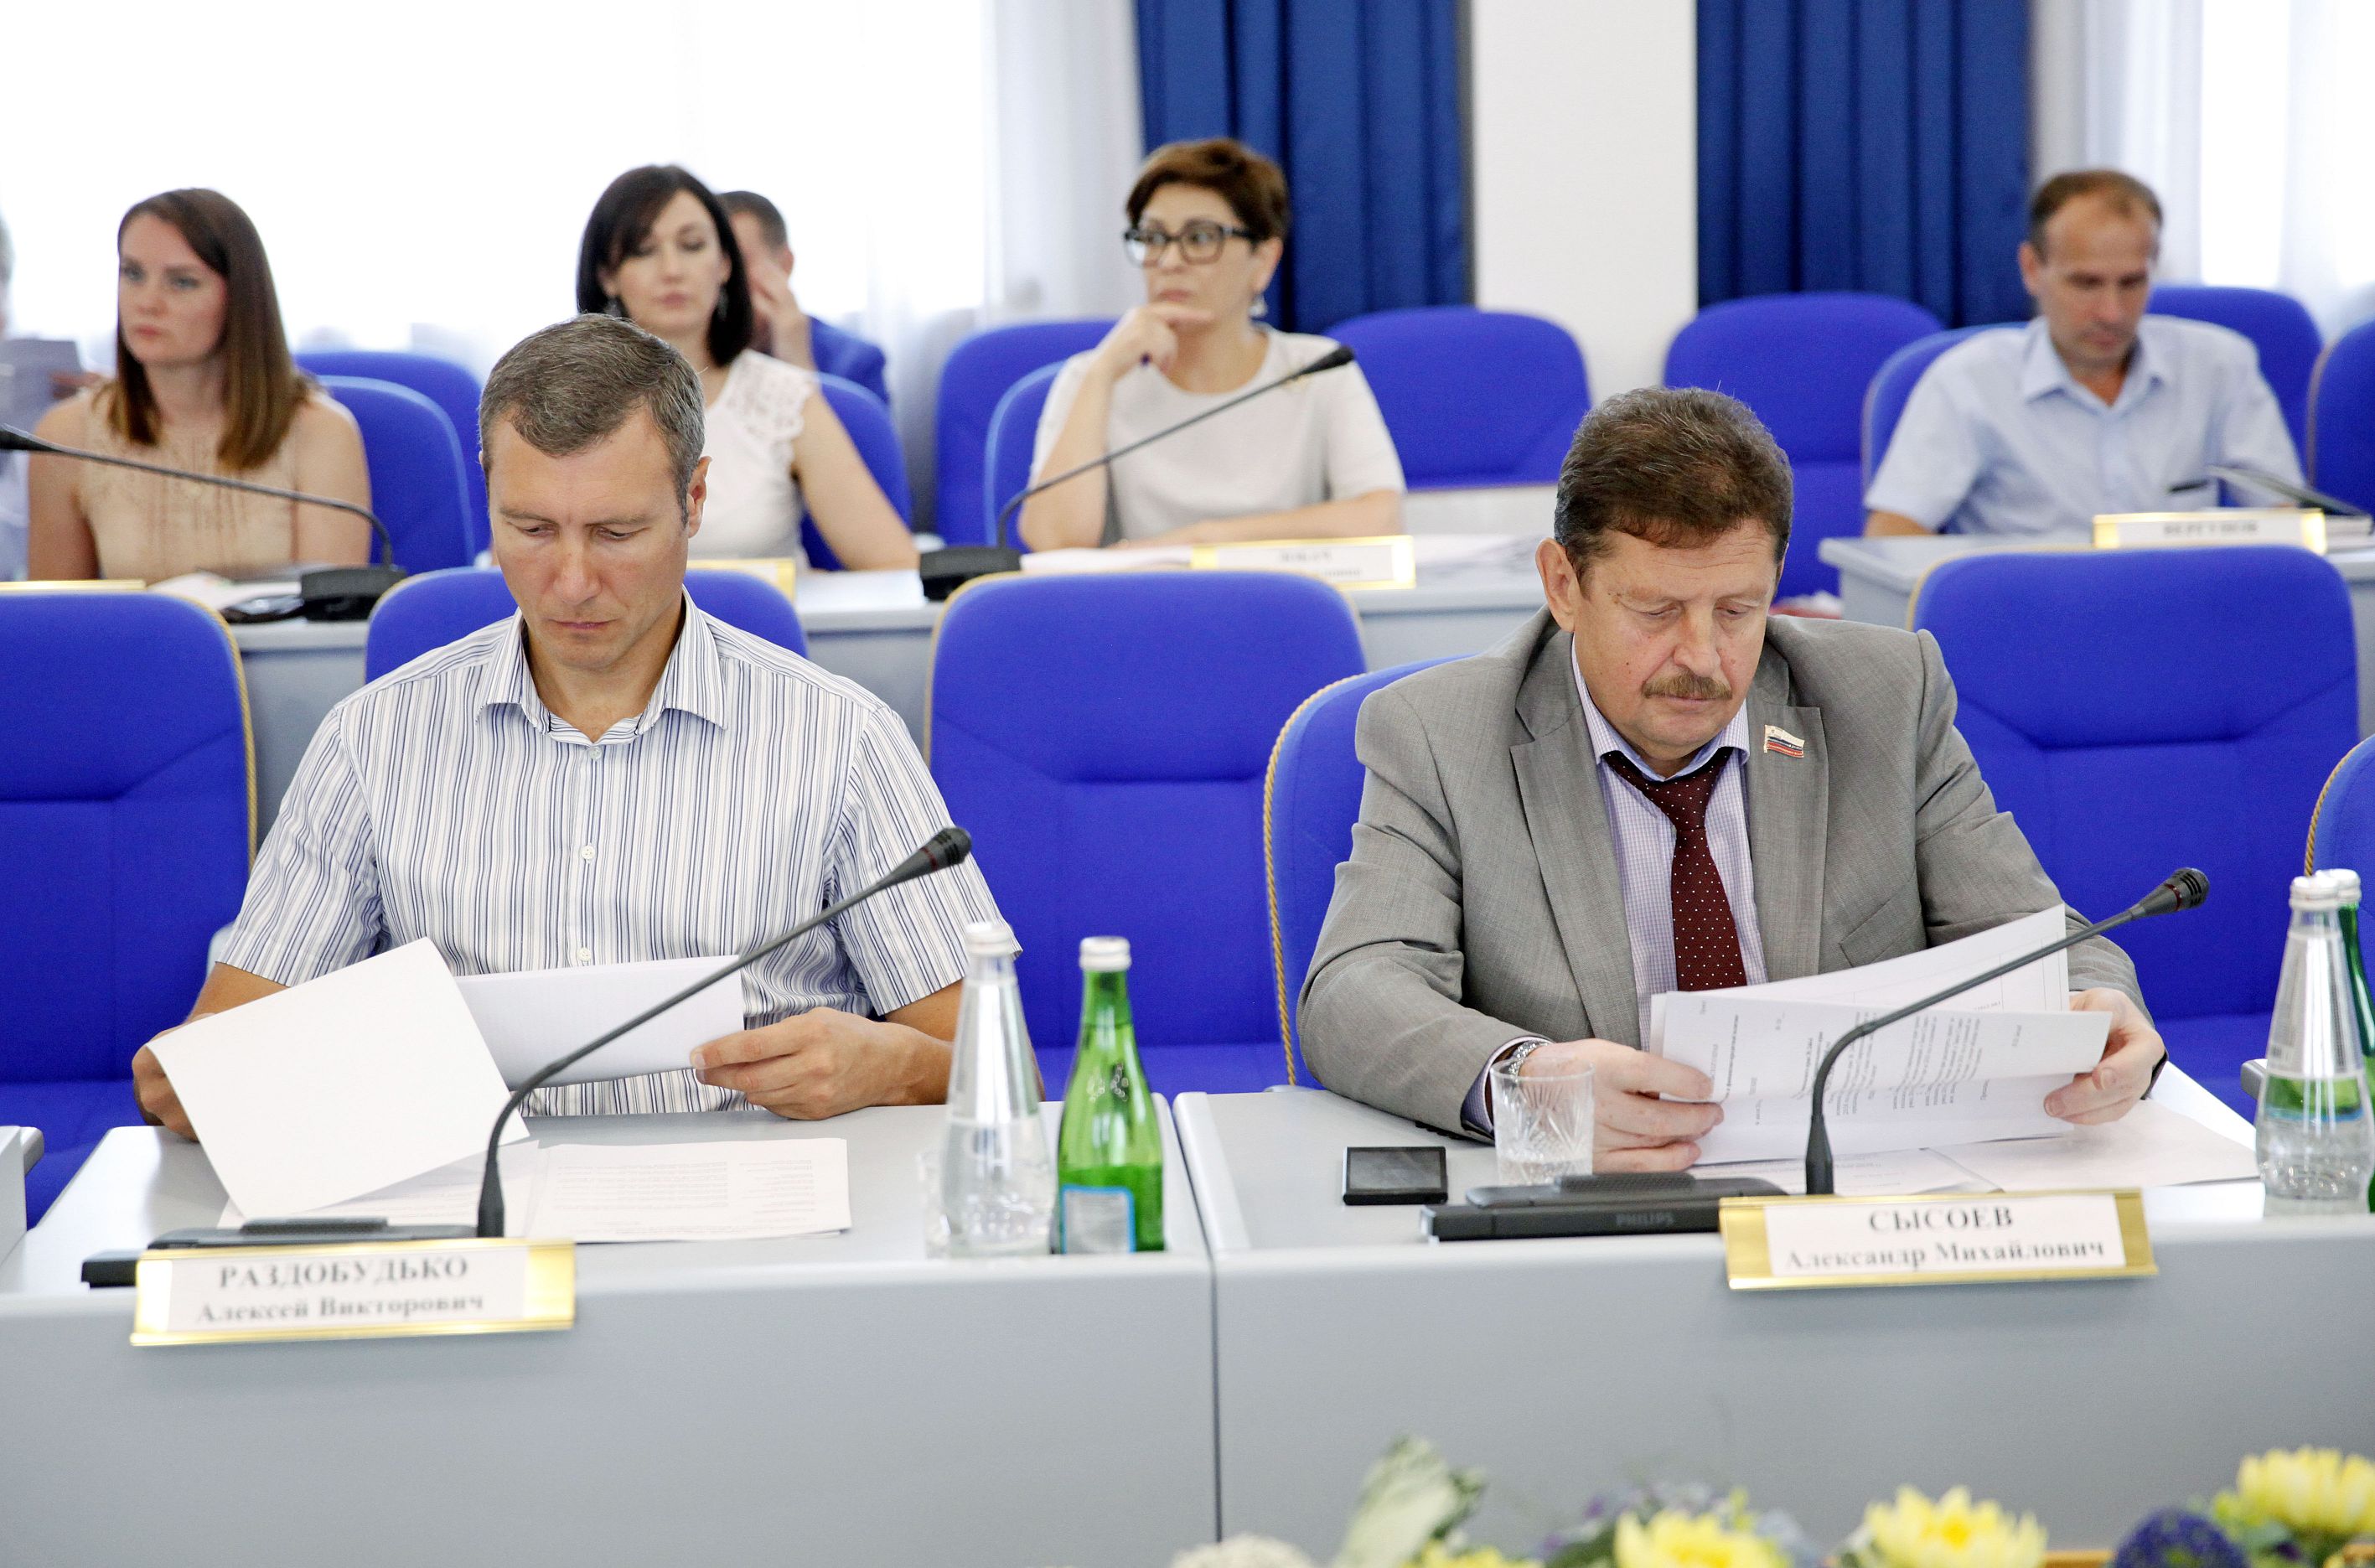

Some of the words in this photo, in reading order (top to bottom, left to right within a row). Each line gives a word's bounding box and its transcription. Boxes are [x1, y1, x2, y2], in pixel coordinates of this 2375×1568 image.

[1870, 1205, 2014, 1233] СЫСОЕВ
[1785, 1248, 1928, 1271] Александр
[1937, 1239, 2106, 1265] Михайлович
[220, 1256, 468, 1288] РАЗДОБУДЬКО
[198, 1299, 310, 1322] Алексей
[319, 1295, 484, 1320] Викторович
